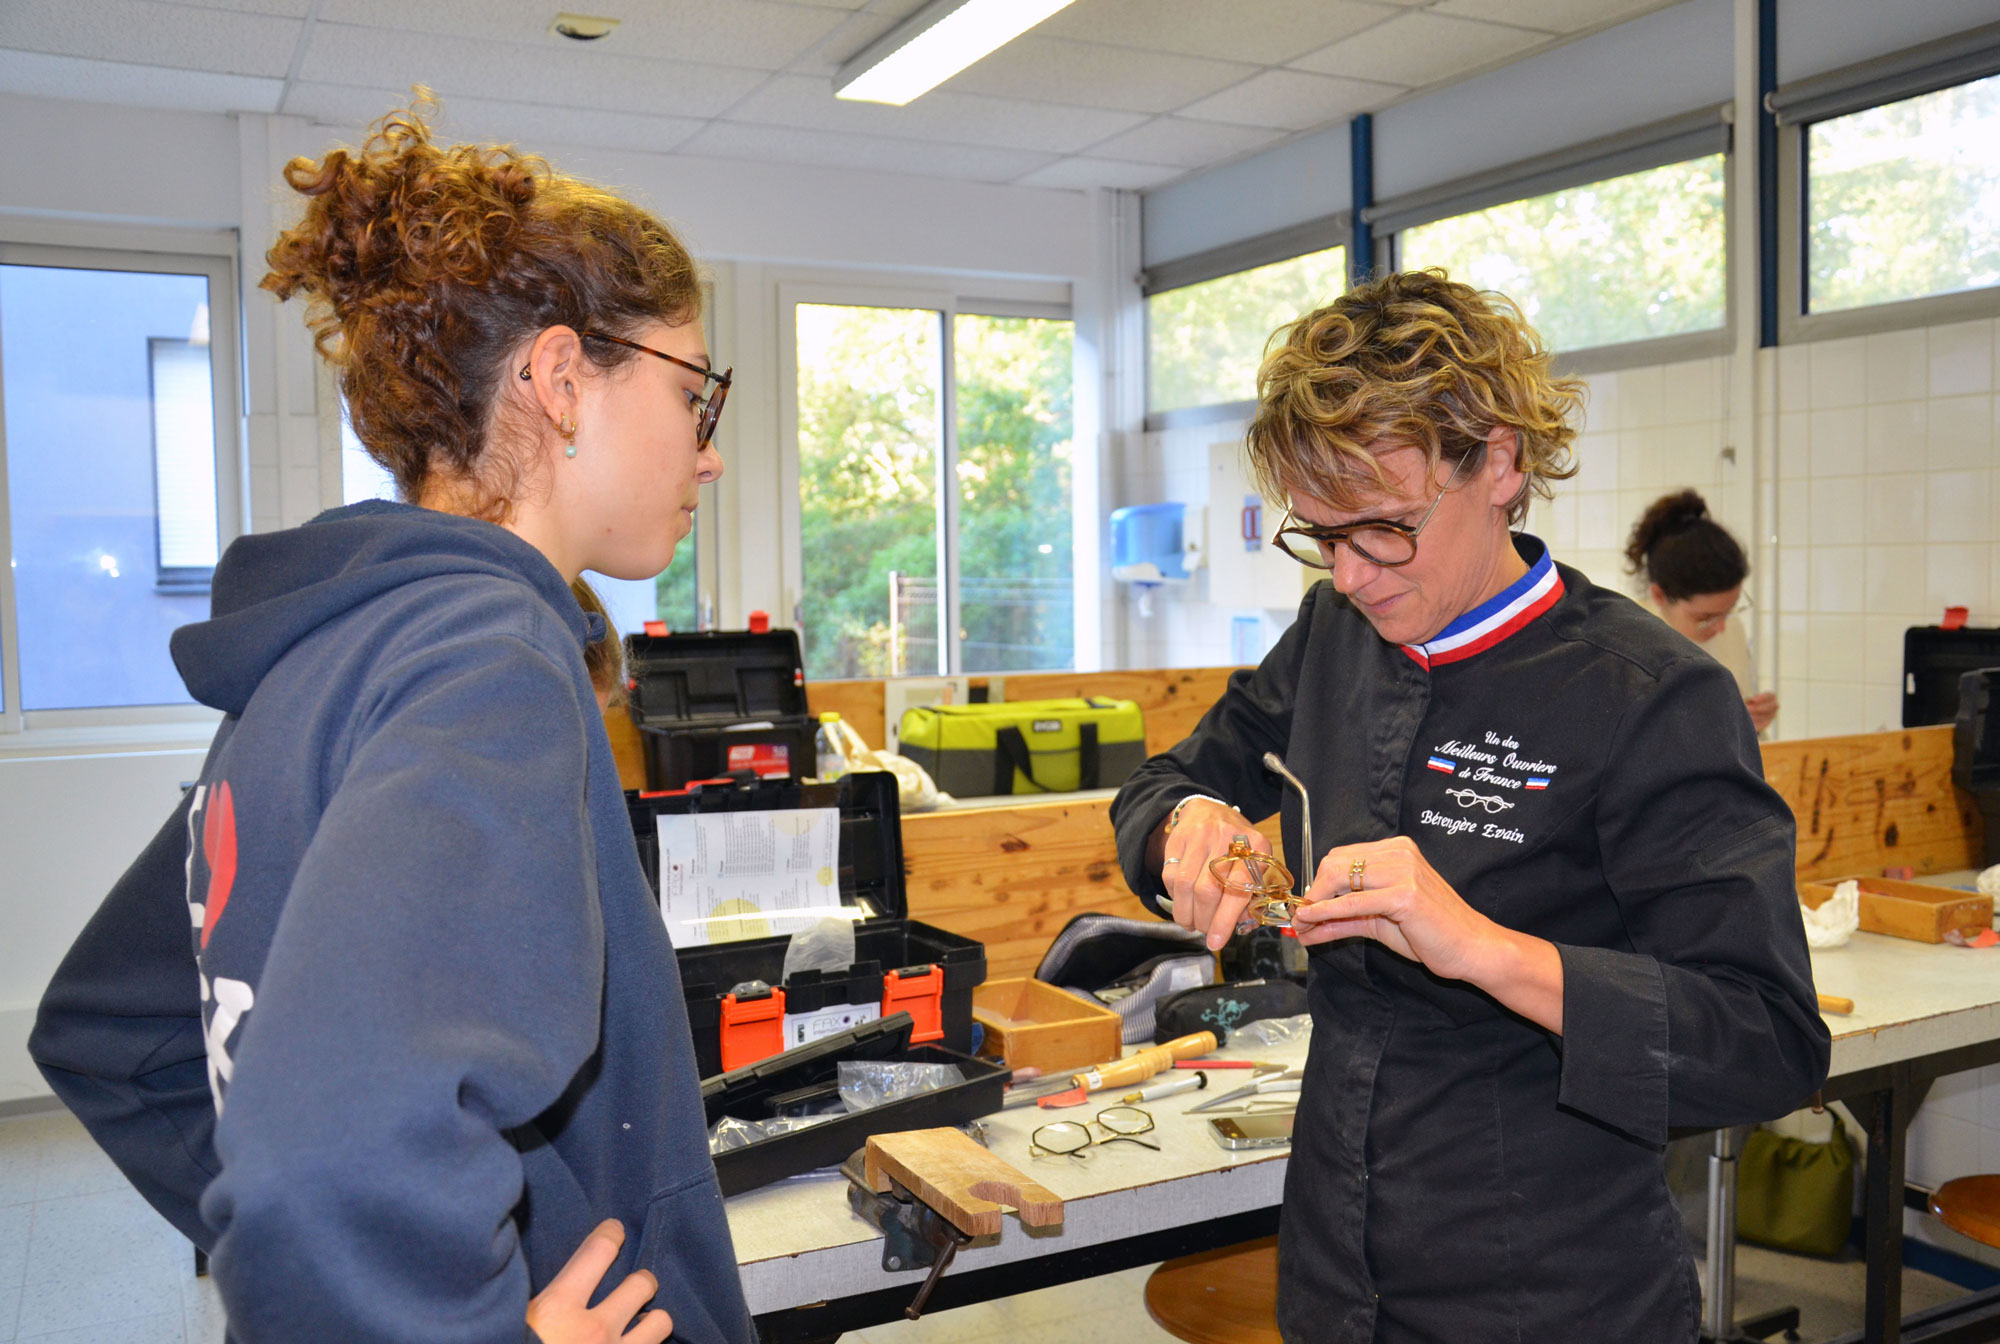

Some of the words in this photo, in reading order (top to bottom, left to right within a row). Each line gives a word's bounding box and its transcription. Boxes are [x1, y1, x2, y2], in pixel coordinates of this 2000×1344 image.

[1485, 731, 1500, 745] Un
[1502, 735, 1520, 750] des
[1434, 740, 1498, 764] Meilleurs
[1503, 752, 1557, 774] Ouvriers
[1458, 767, 1472, 779] de
[1473, 766, 1522, 789] France
[1420, 810, 1477, 835] Bérengère
[1482, 823, 1525, 844] Evain
